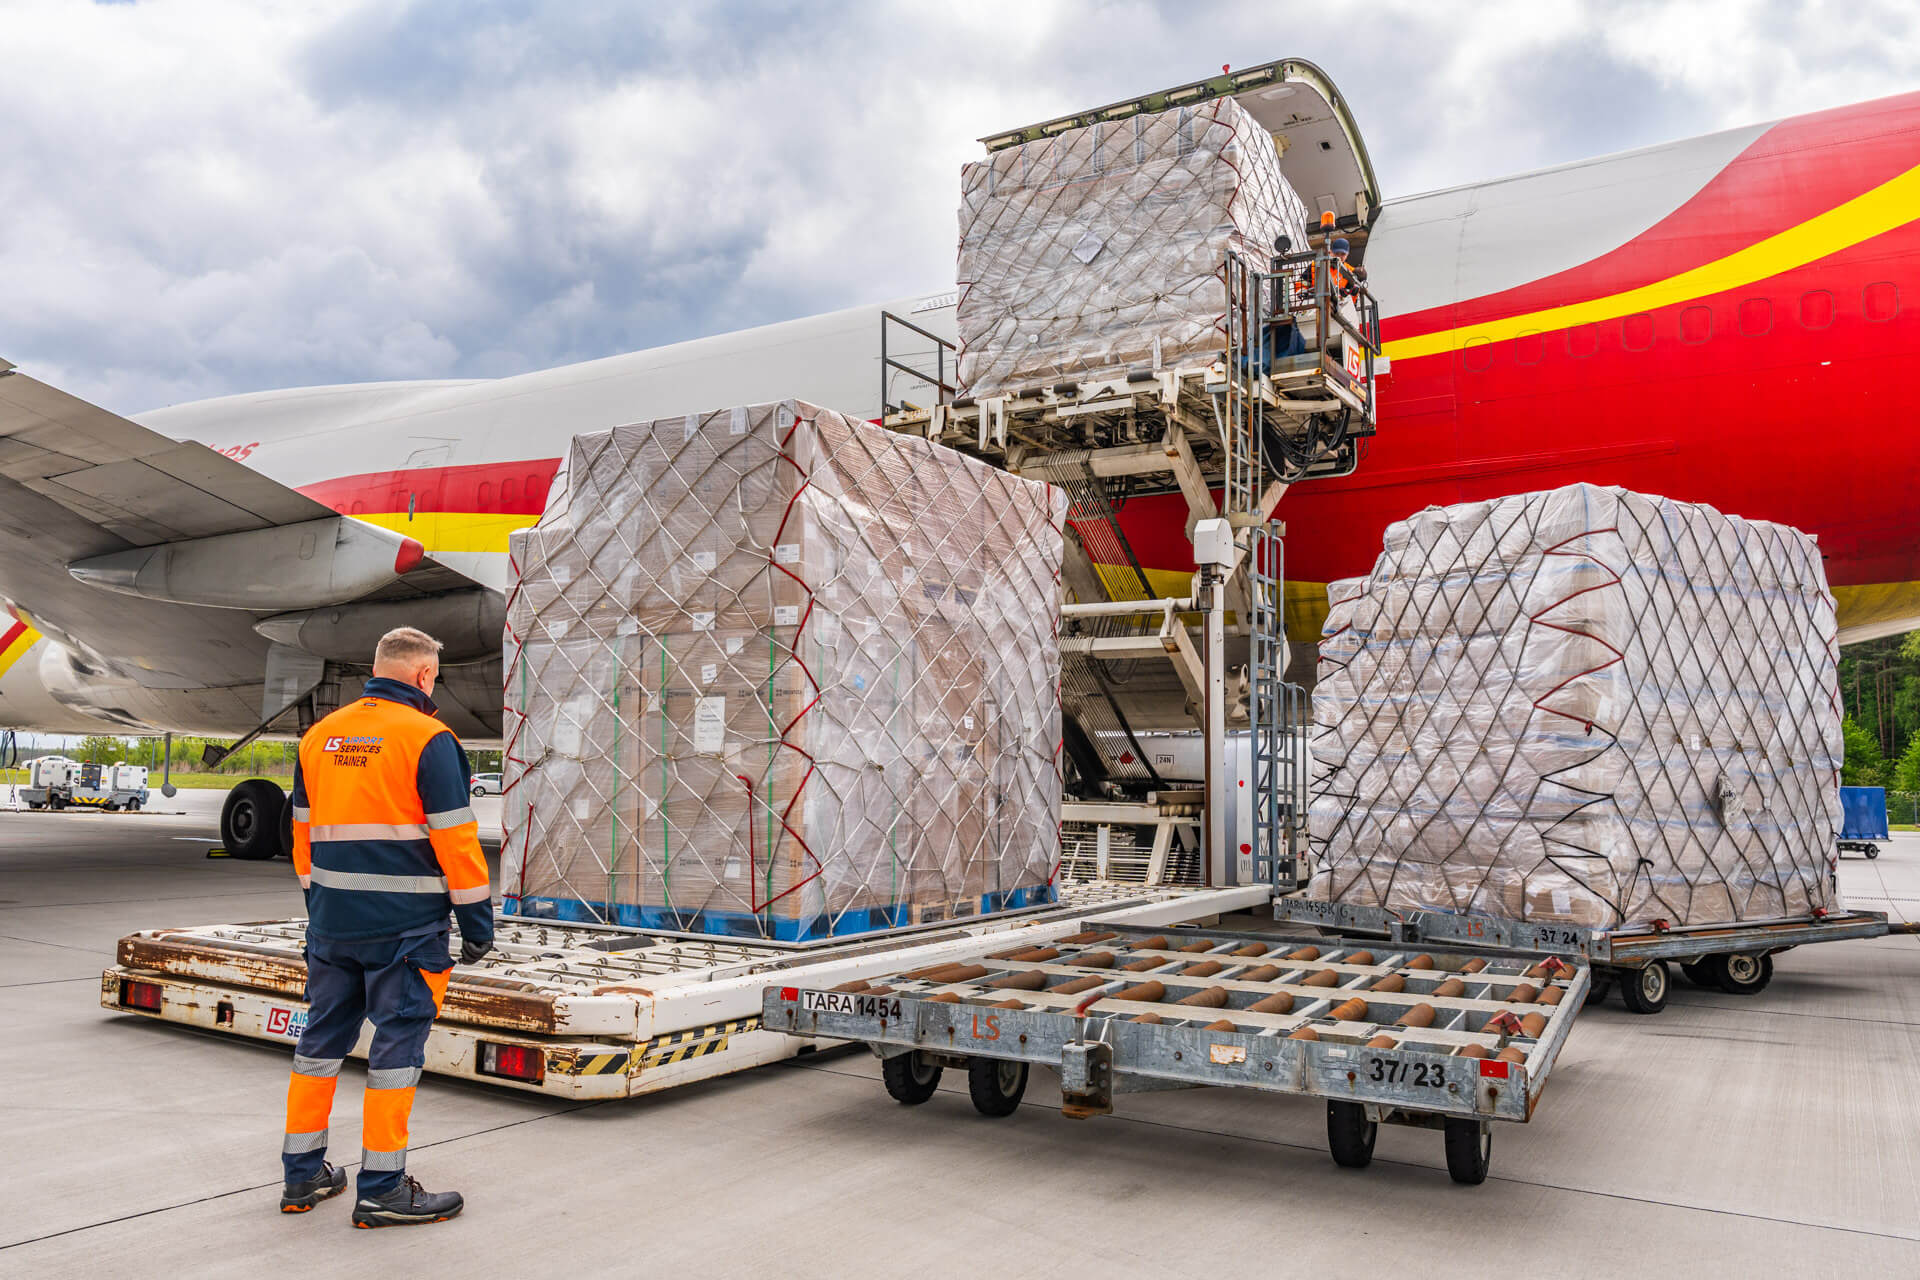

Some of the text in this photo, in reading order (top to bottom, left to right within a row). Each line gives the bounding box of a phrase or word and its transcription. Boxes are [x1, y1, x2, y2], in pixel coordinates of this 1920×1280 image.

[1348, 346, 1360, 378] LS
[323, 736, 345, 752] LS
[340, 745, 382, 754] SERVICES
[345, 737, 384, 745] AIRPORT
[334, 754, 368, 768] TRAINER
[1468, 921, 1484, 938] LS
[1541, 929, 1578, 945] 37 24
[804, 991, 902, 1020] TARA 1454
[267, 1009, 290, 1033] LS
[971, 1013, 1000, 1041] LS
[1370, 1058, 1445, 1088] 37/23
